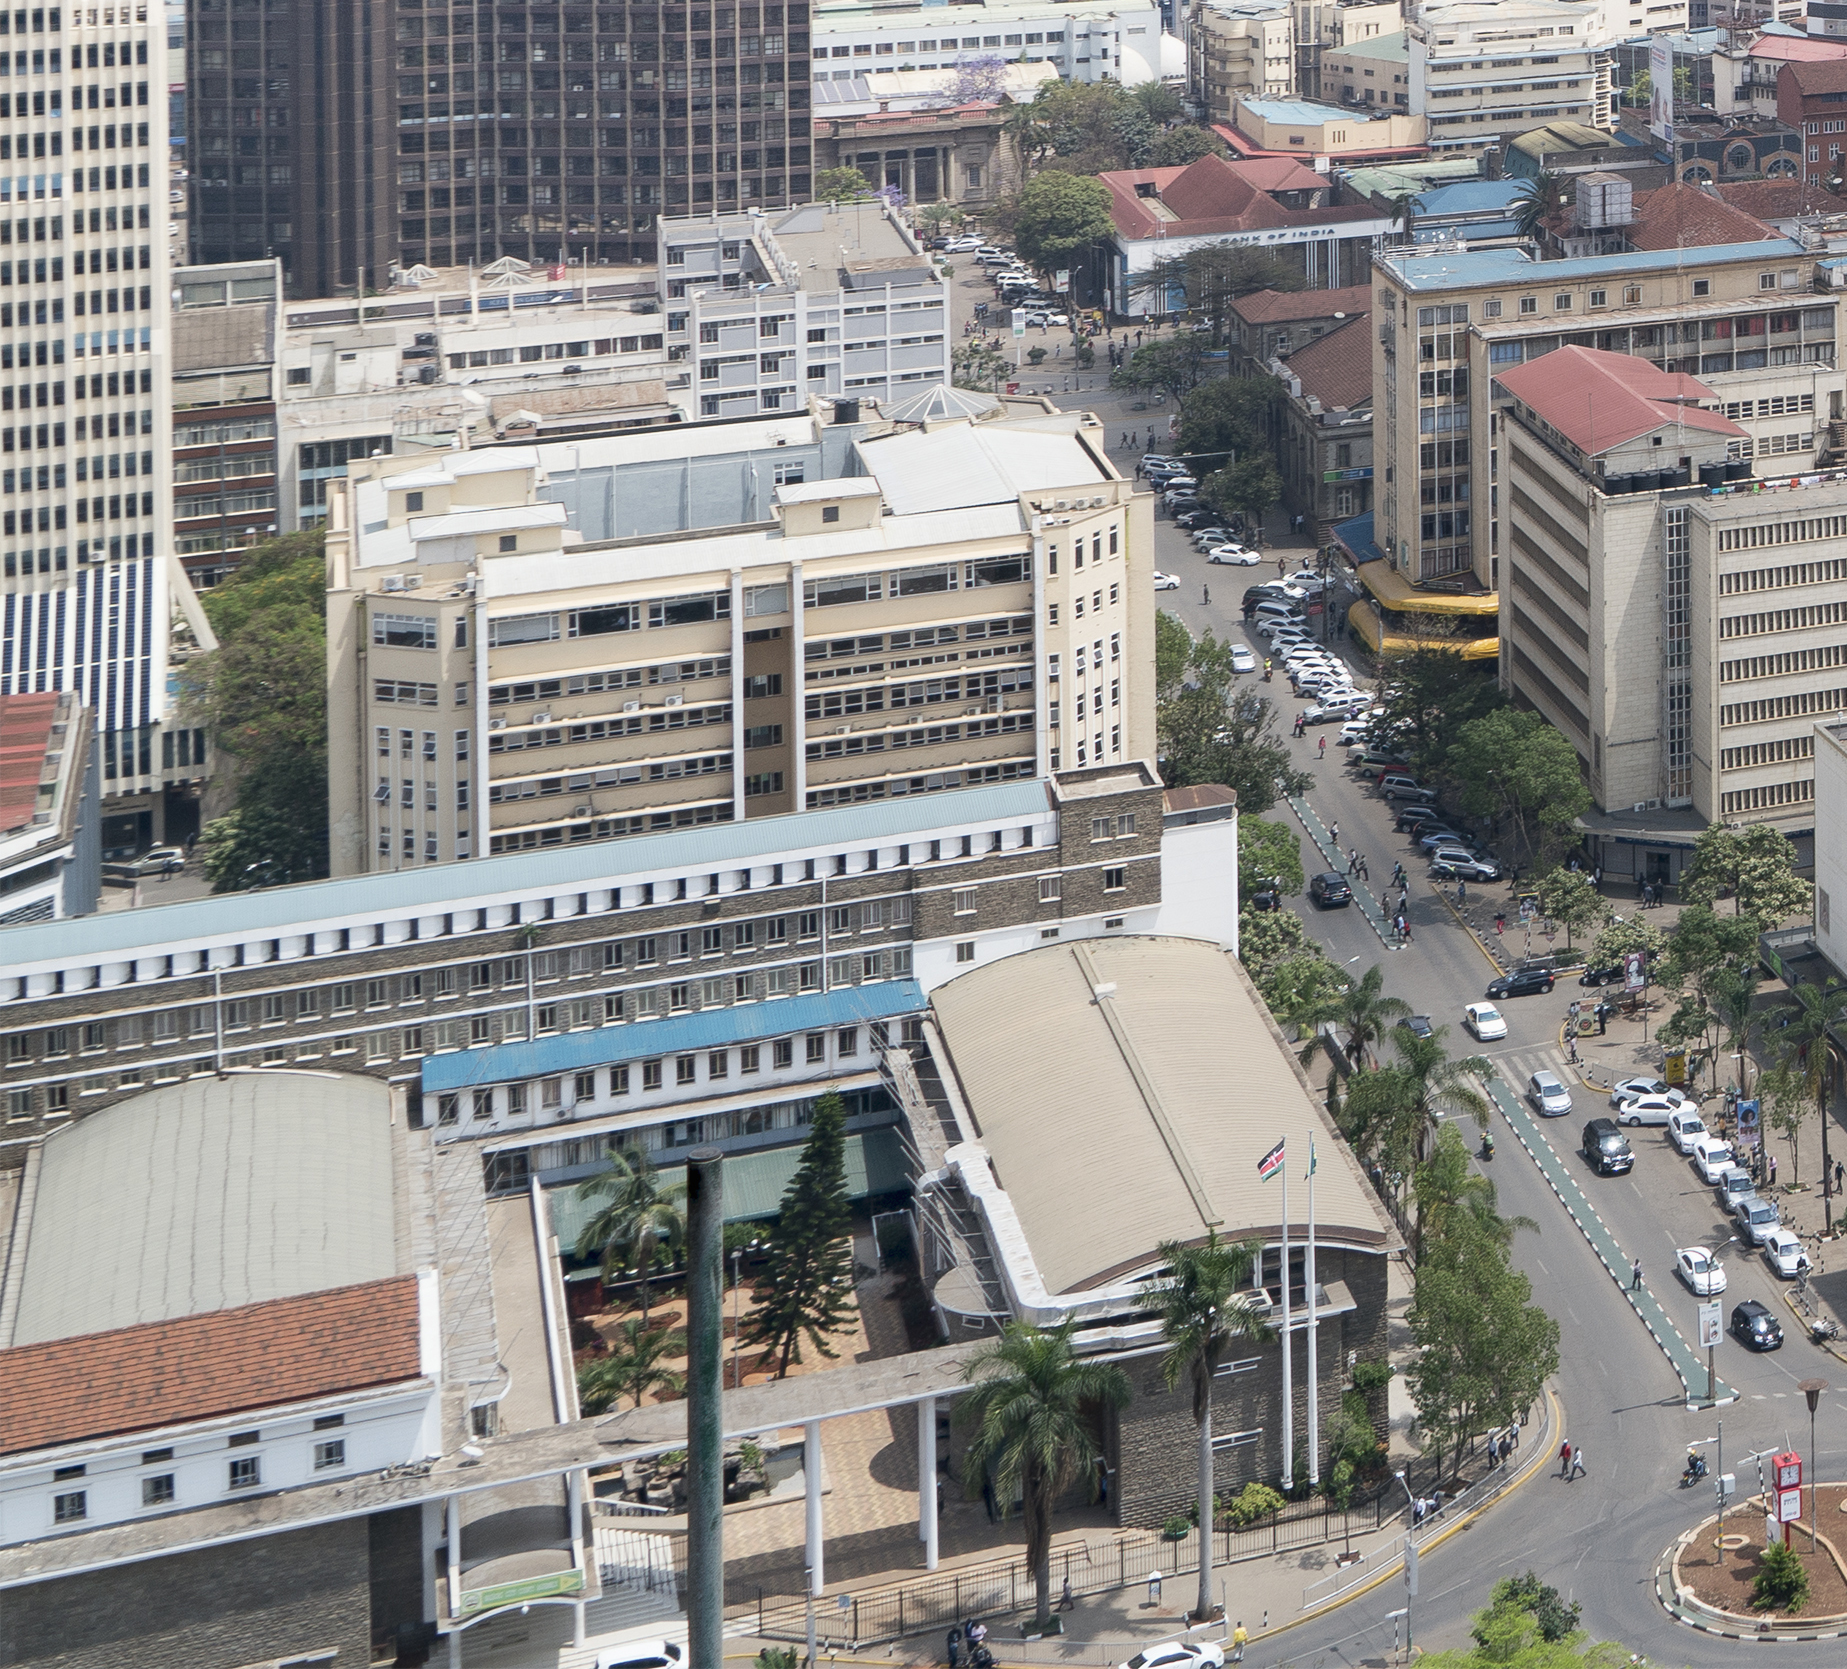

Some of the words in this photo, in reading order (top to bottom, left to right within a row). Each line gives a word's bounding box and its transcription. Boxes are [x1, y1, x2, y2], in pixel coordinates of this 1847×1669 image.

[1220, 234, 1262, 244] BANK
[1267, 232, 1288, 240] OF
[1292, 228, 1336, 238] INDIA
